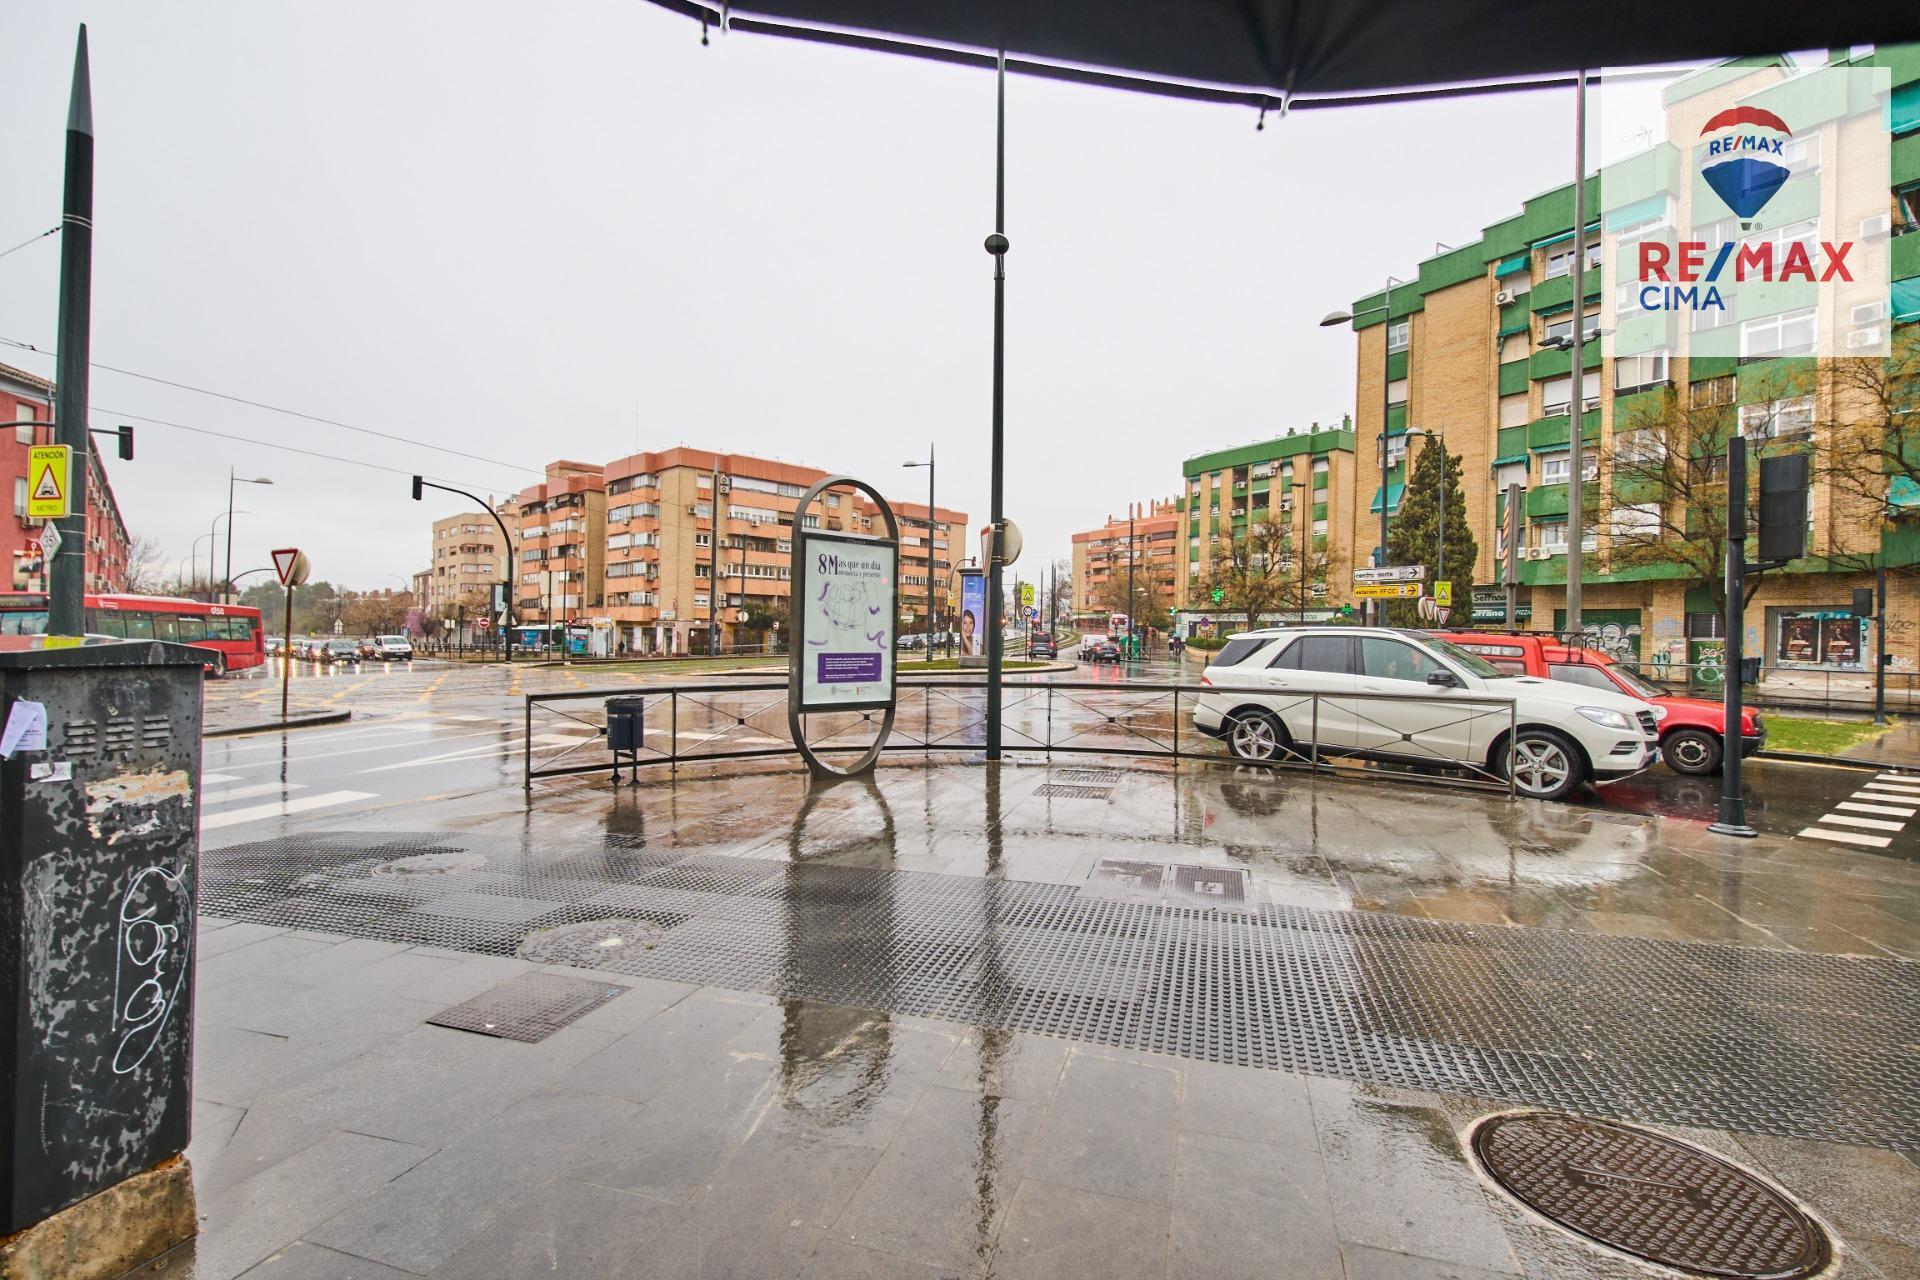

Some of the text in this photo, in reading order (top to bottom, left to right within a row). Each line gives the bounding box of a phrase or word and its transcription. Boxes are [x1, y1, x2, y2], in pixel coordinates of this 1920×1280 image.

[847, 561, 860, 571] que
[1474, 593, 1507, 602] Serrano
[211, 606, 225, 615] alsa
